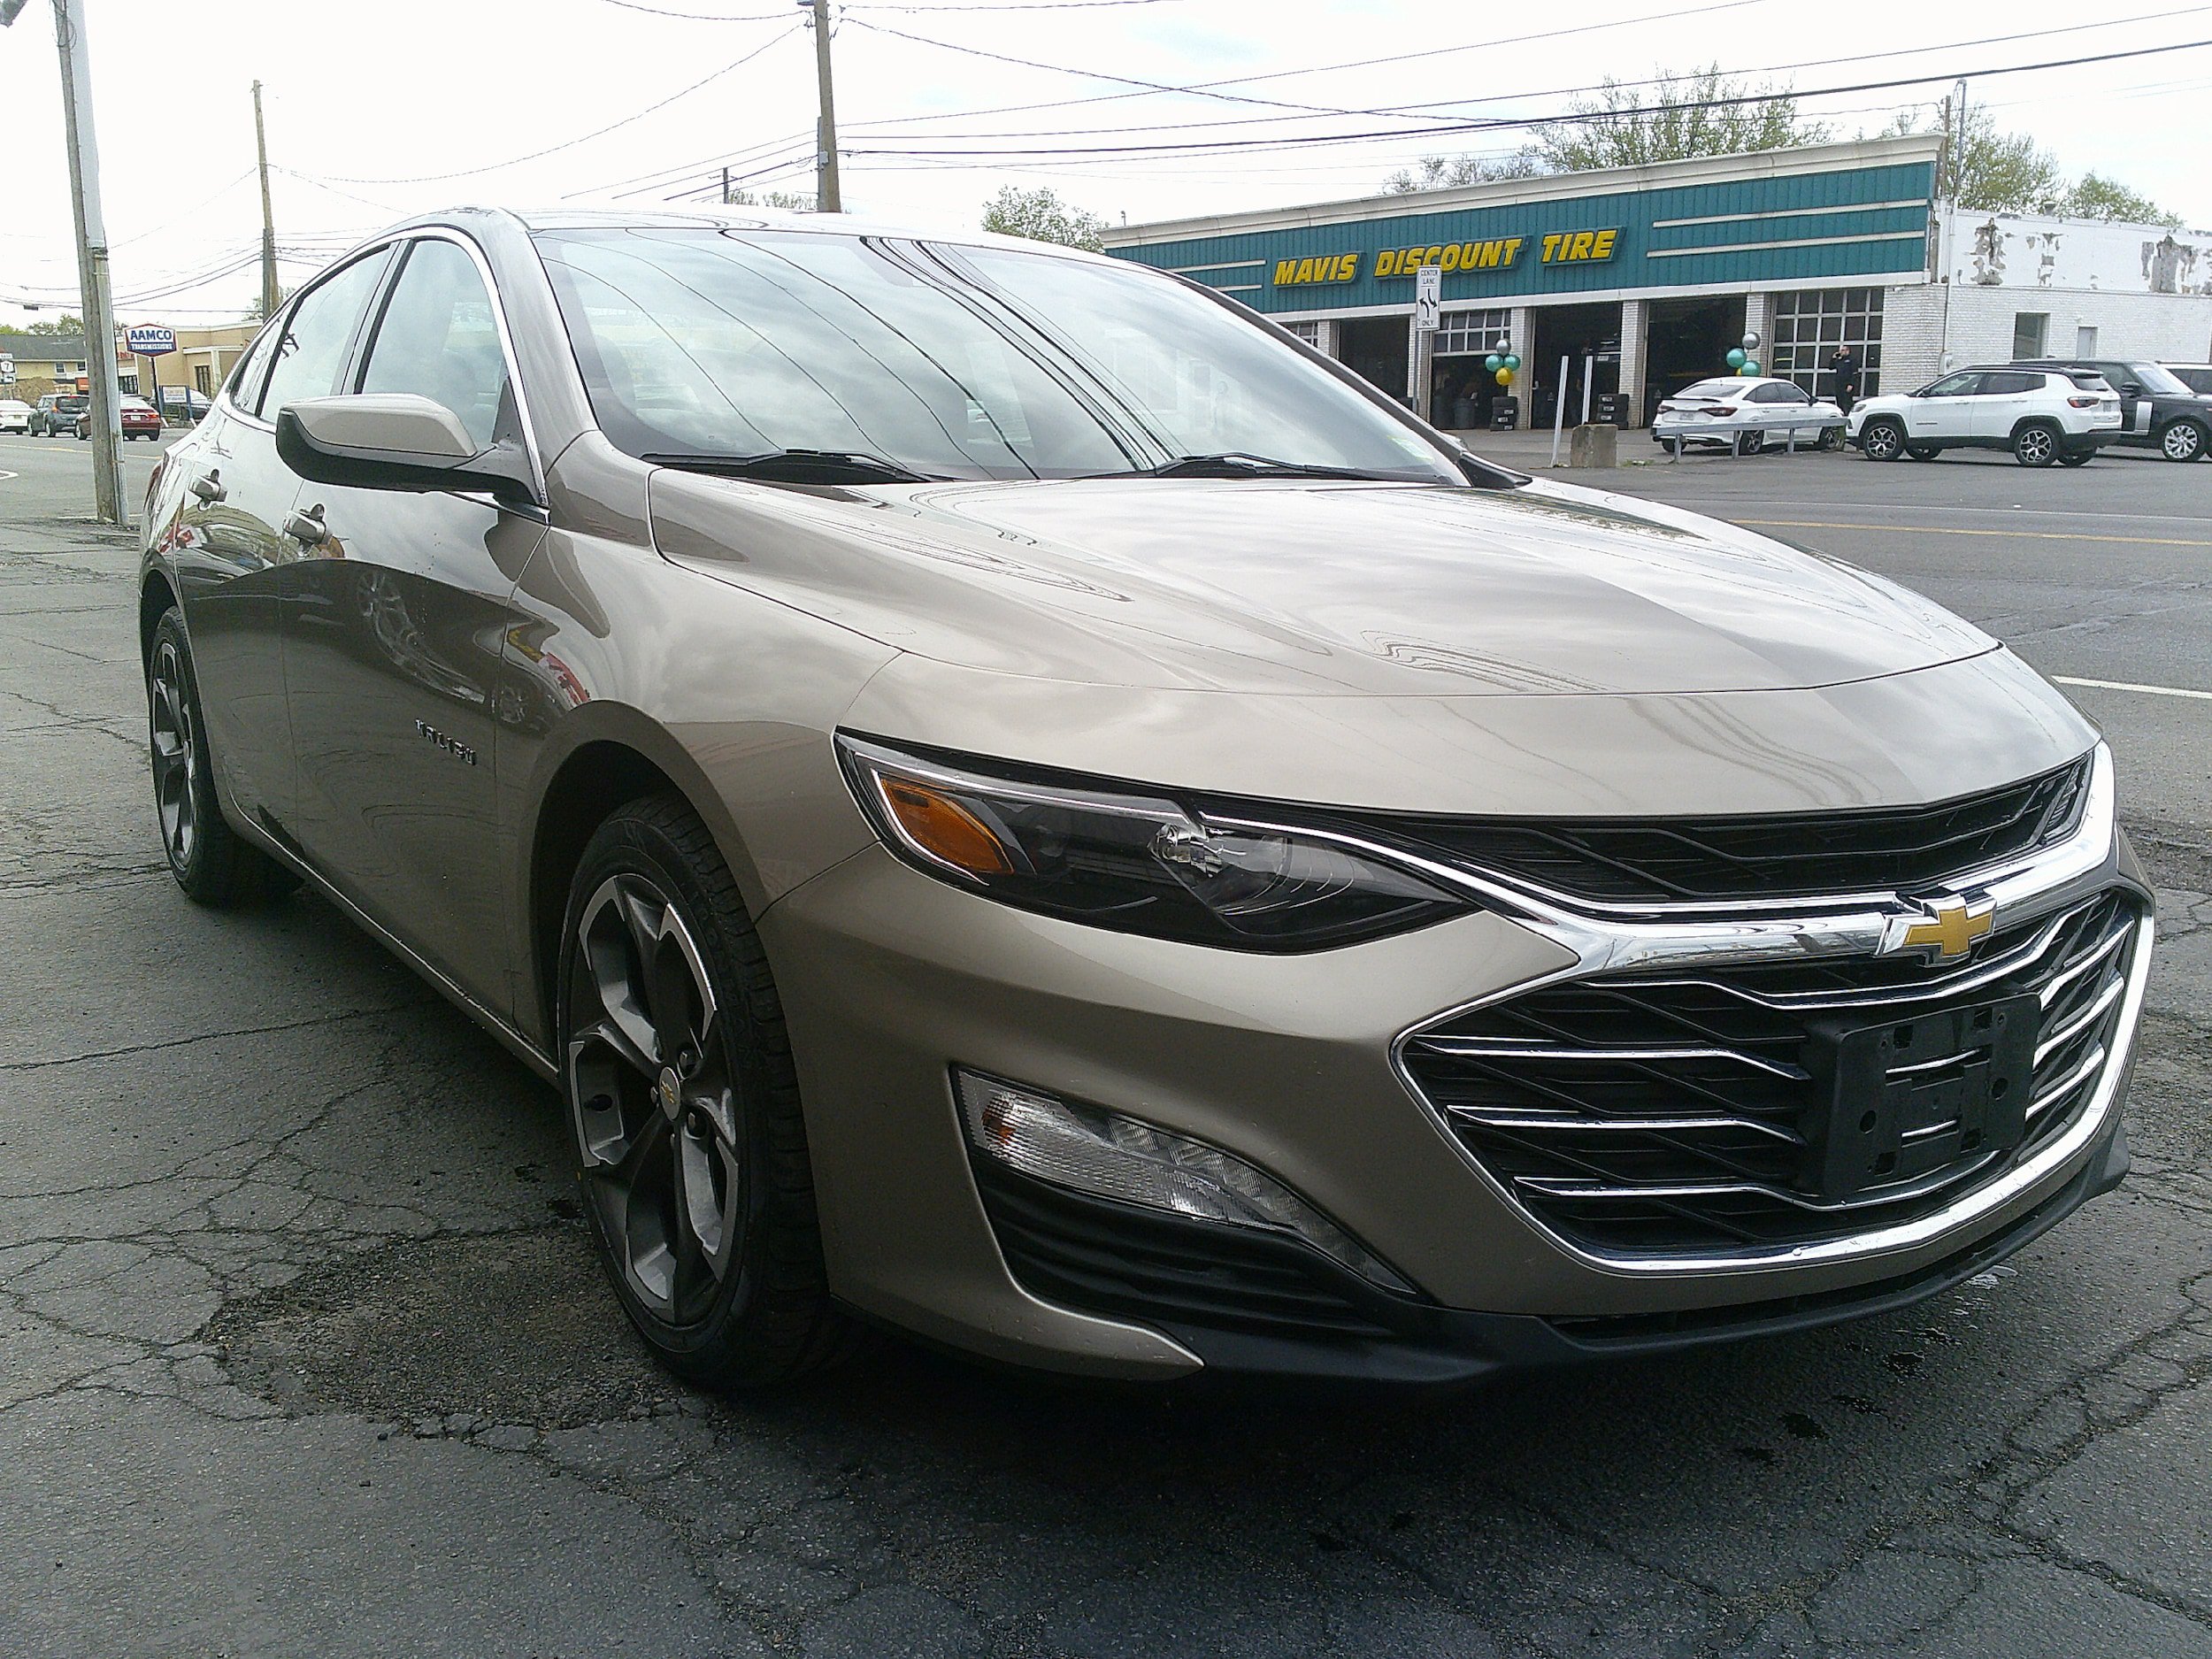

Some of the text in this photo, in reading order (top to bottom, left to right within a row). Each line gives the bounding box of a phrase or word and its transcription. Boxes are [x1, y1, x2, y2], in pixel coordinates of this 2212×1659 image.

[1273, 229, 1617, 285] MAVIS DISCOUNT TIRE
[130, 330, 173, 341] AAMCO
[4, 362, 10, 371] 7
